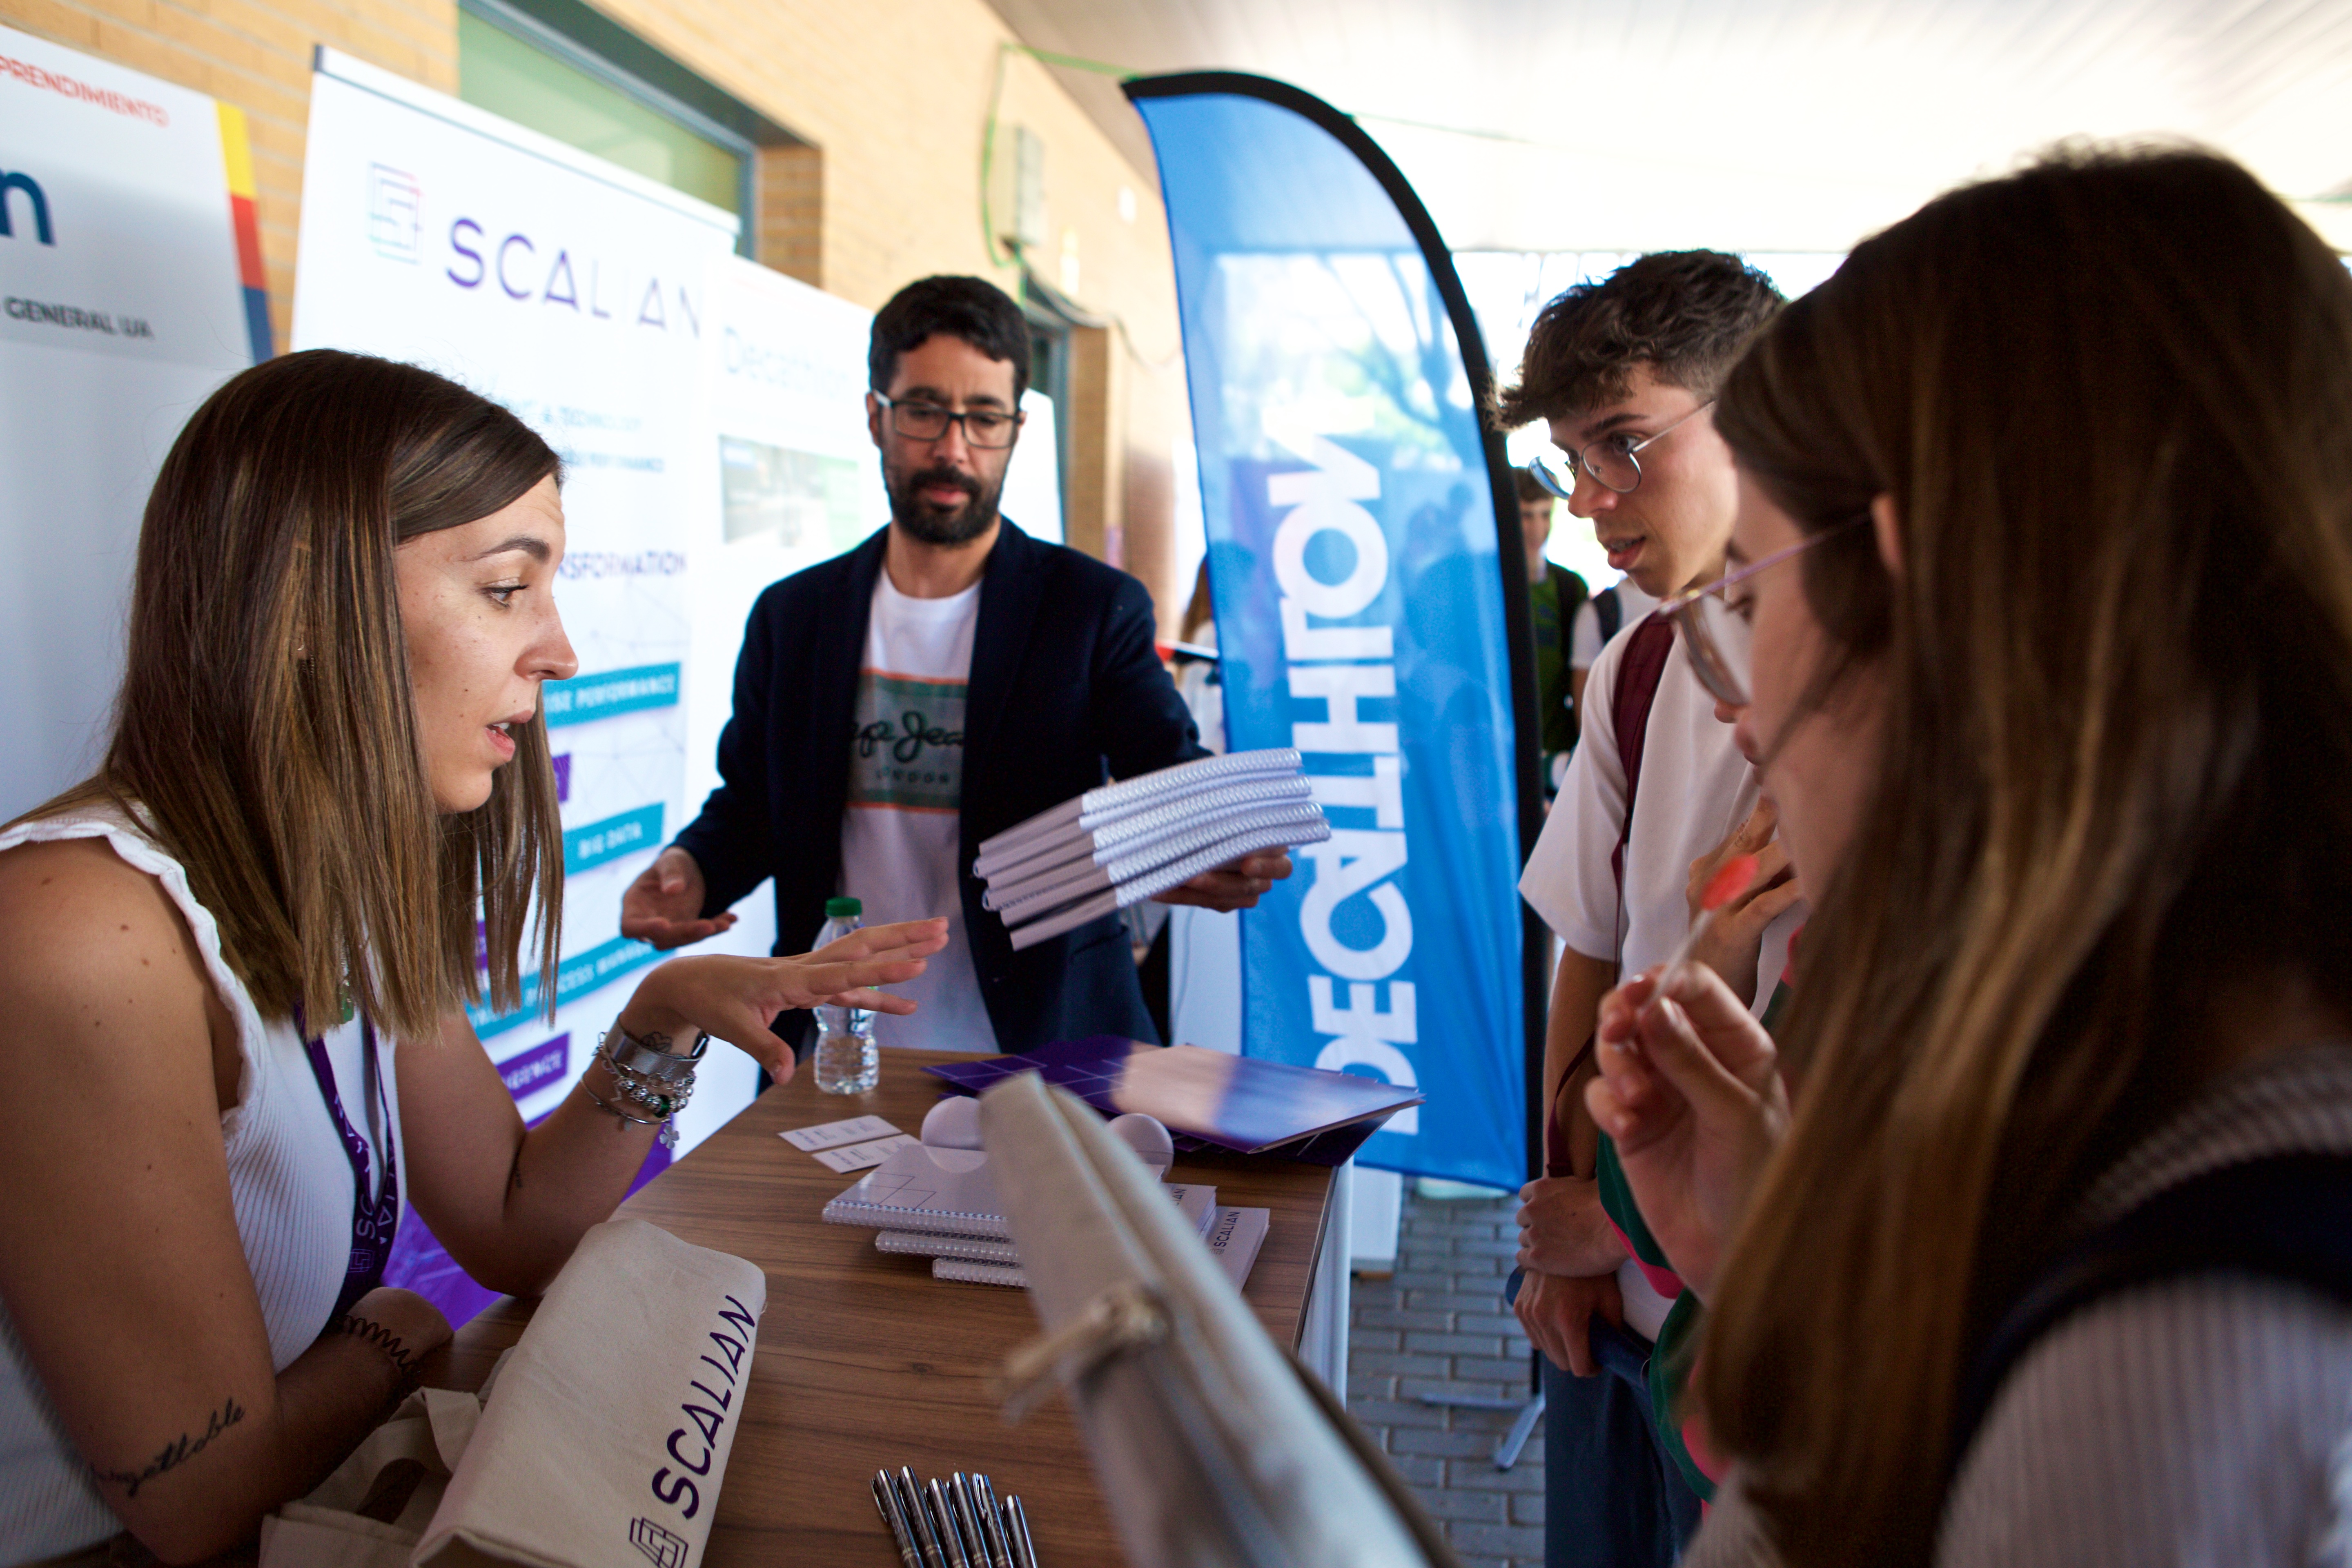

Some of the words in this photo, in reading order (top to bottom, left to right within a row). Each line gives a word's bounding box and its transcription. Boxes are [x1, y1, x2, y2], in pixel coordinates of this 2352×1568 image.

[4, 296, 117, 336] GENERAL
[445, 216, 702, 338] SCALIAN
[1214, 1212, 1241, 1247] SCALIAN
[652, 1295, 756, 1520] SCALIAN
